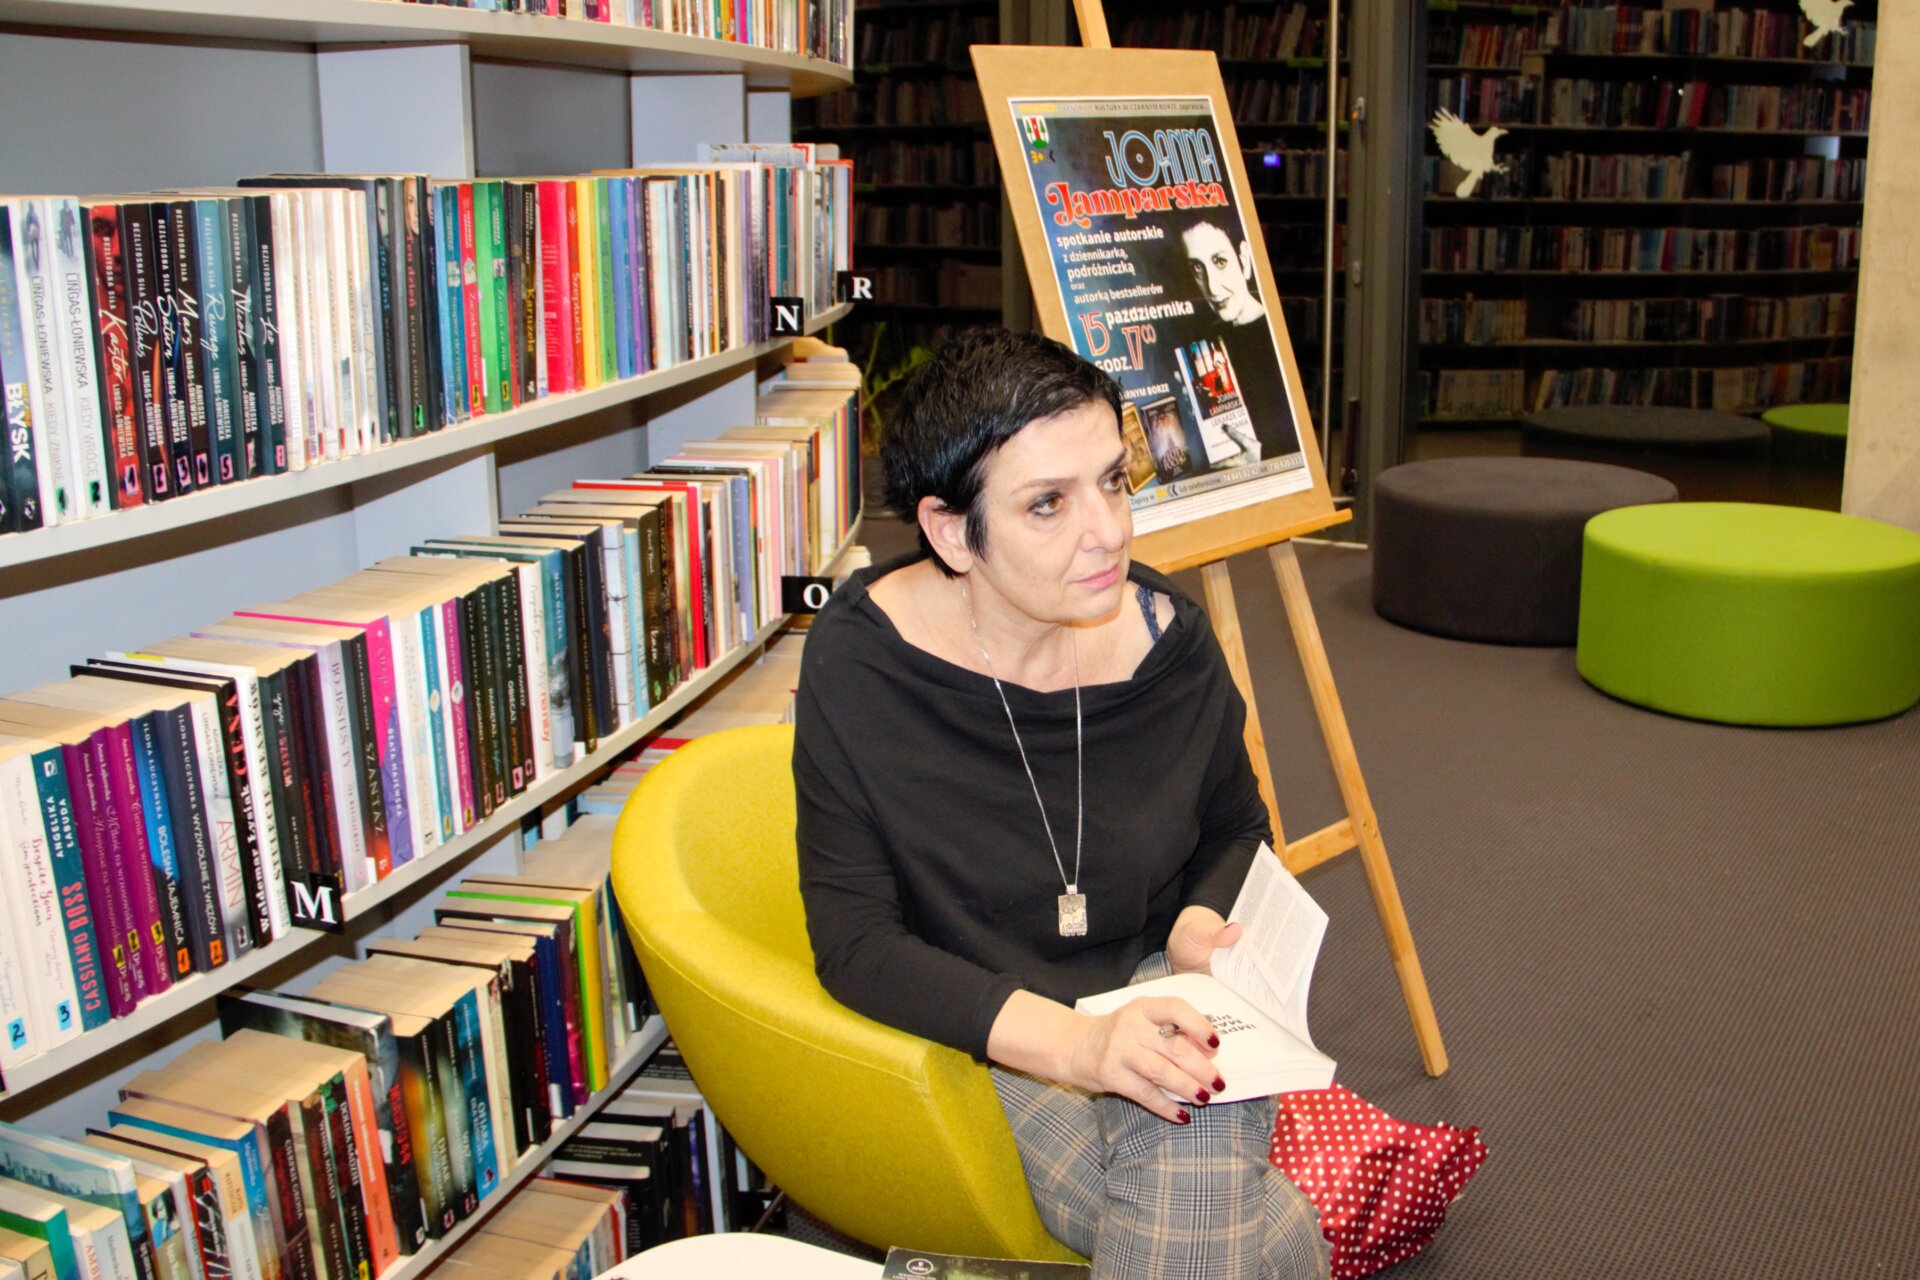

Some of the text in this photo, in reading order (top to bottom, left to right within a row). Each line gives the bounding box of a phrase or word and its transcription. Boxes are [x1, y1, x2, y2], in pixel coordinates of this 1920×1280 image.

[1103, 127, 1222, 187] JOANNA
[1056, 226, 1165, 249] spotkanie autorskie
[1063, 247, 1129, 263] z dziennikarką,
[852, 276, 873, 299] R
[1067, 261, 1136, 281] podróżniczką
[1070, 282, 1085, 290] oraz
[1074, 283, 1164, 305] autorką bestsellerów
[65, 272, 89, 389] LINGAS-ŁONIEWSKA
[178, 288, 199, 345] Mars
[526, 288, 535, 352] Karuzela
[573, 272, 582, 344] Szeptucha
[775, 305, 799, 331] N
[32, 275, 53, 394] LINGAS-ŁONIEWSKA
[99, 309, 129, 383] Kastor
[1078, 312, 1110, 357] 15
[1120, 383, 1169, 400] ARNYM BORZE
[5, 383, 31, 463] BŁYSK
[803, 583, 829, 609] O
[332, 662, 340, 684] BO
[387, 728, 402, 817] BEATA MAJEWSKA
[58, 798, 75, 849] ŁABUDA
[178, 714, 188, 747] ILONA
[183, 750, 196, 810] ŁUCZYŃSKA
[192, 812, 210, 885] WYZWOLENIE
[225, 692, 270, 934] Waldemar Łysiak CENA
[47, 796, 65, 858] ANGELIKA
[143, 723, 184, 945] ILONA ŁUCZYŃSKA BOLESNA TAJEMNICA
[31, 835, 46, 889] Despite
[216, 819, 244, 909] ARMIN
[290, 881, 337, 924] M
[61, 881, 101, 1011] CASSIANO BOSS
[11, 1022, 25, 1042] 2
[60, 1005, 70, 1023] 3
[319, 1120, 328, 1158] WINNE
[339, 1102, 352, 1145] DOLINA
[347, 1145, 359, 1187] NADZIEI
[477, 1101, 489, 1149] OFIARA
